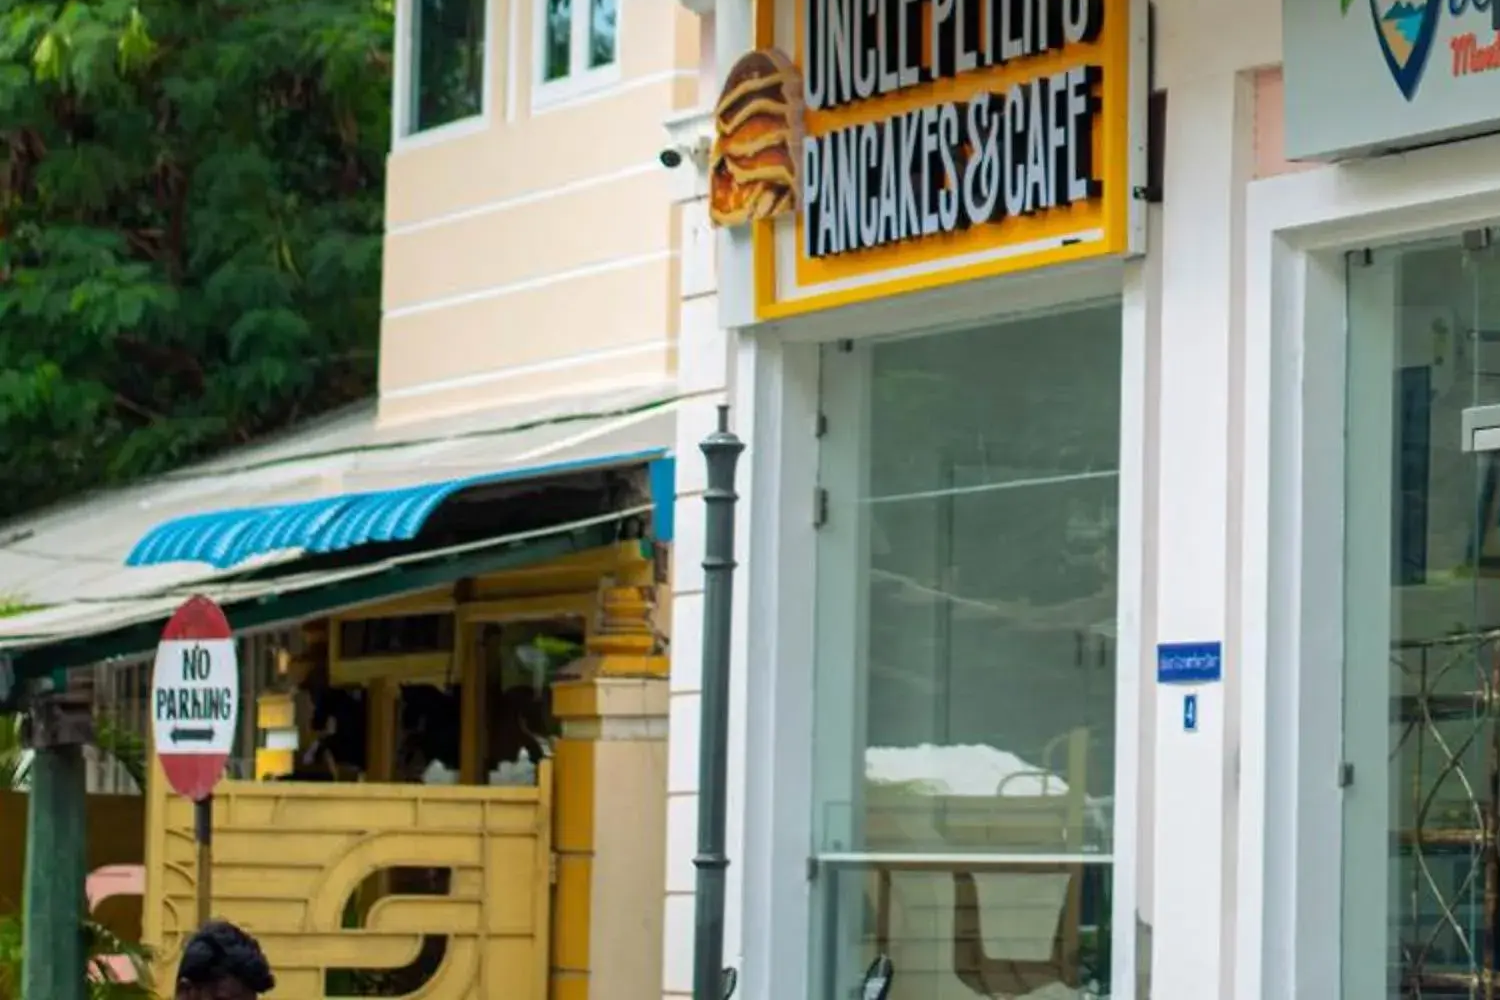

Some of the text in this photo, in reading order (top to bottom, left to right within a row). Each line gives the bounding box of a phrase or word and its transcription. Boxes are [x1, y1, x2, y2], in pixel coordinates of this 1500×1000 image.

[803, 64, 1091, 260] PANCAKES & CAFE
[182, 647, 211, 681] NO
[156, 686, 232, 721] PARKING
